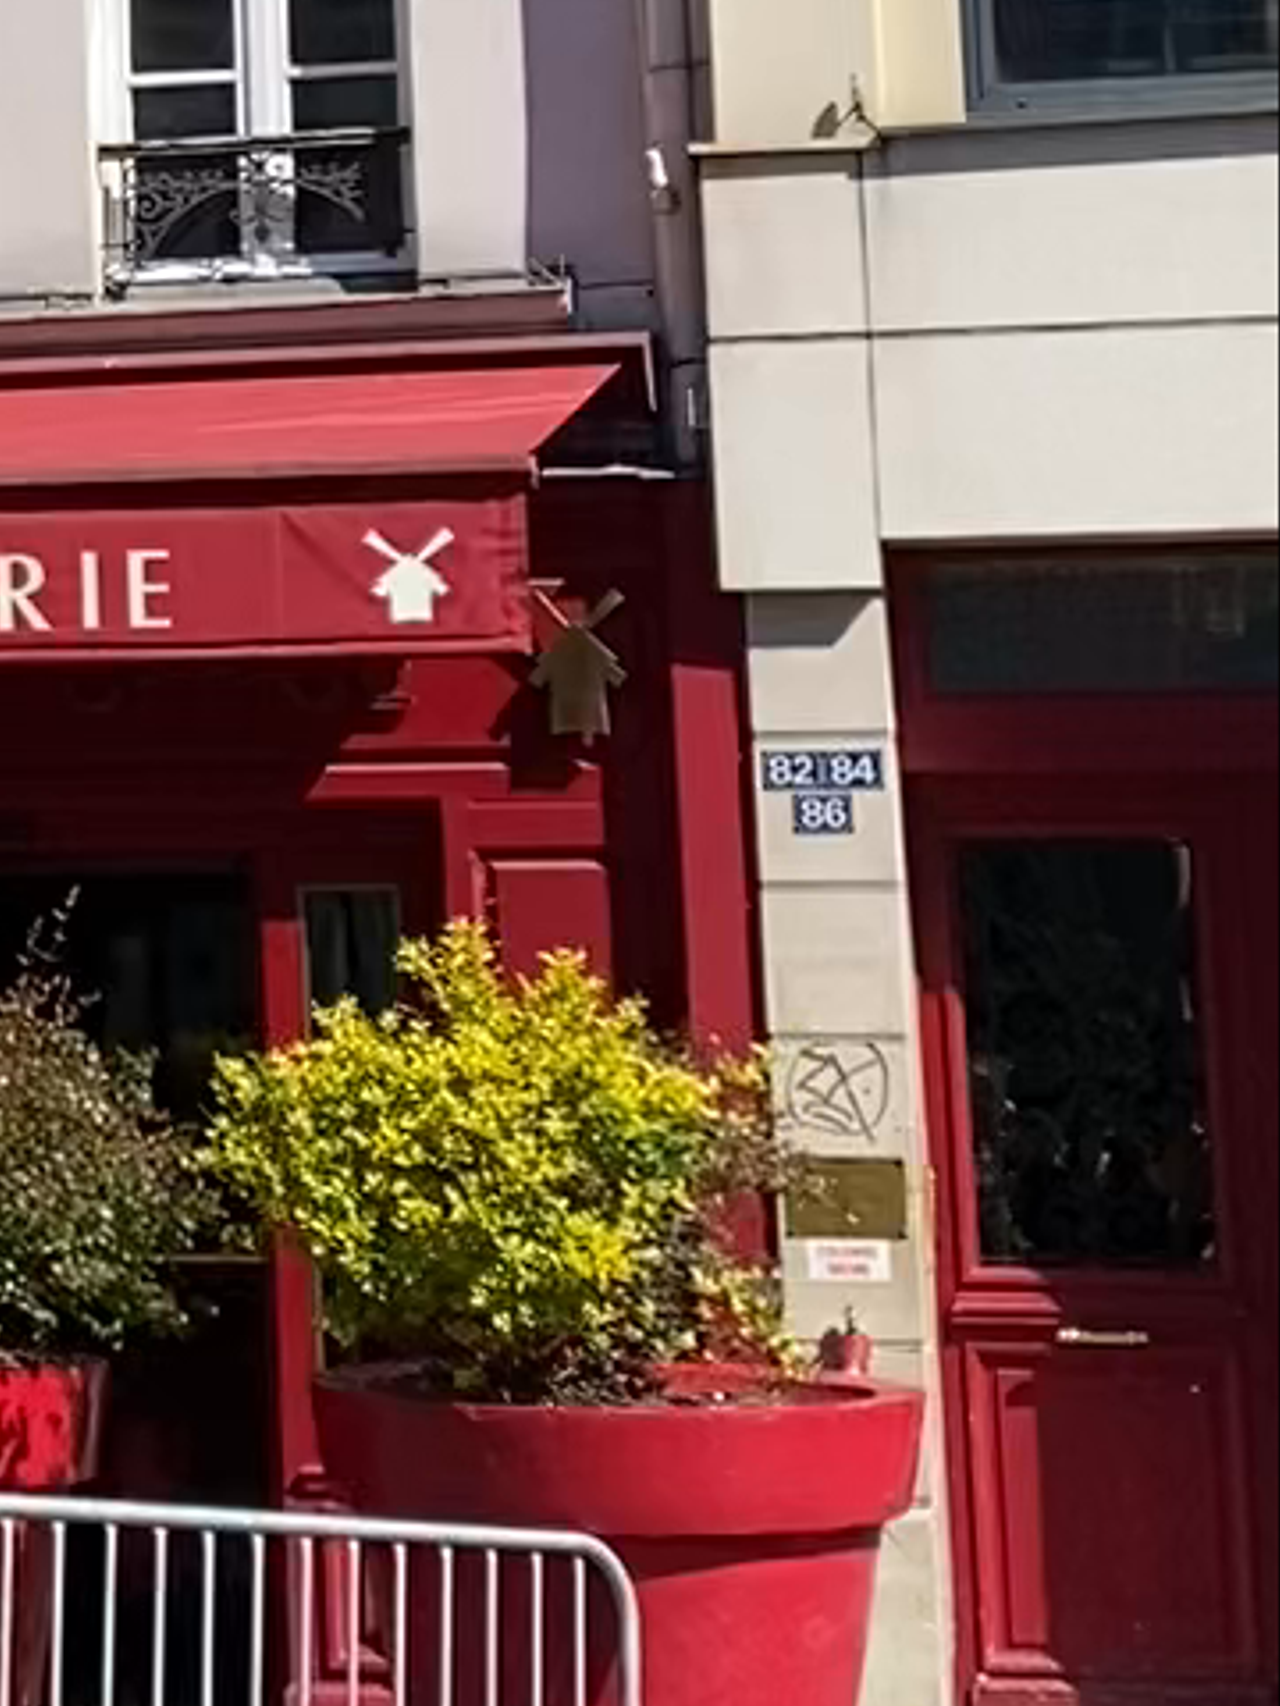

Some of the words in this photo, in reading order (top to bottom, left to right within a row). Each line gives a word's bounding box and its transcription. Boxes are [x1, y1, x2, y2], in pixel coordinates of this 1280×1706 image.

[769, 754, 814, 785] 82
[831, 754, 875, 785] 84
[801, 796, 847, 828] 86
